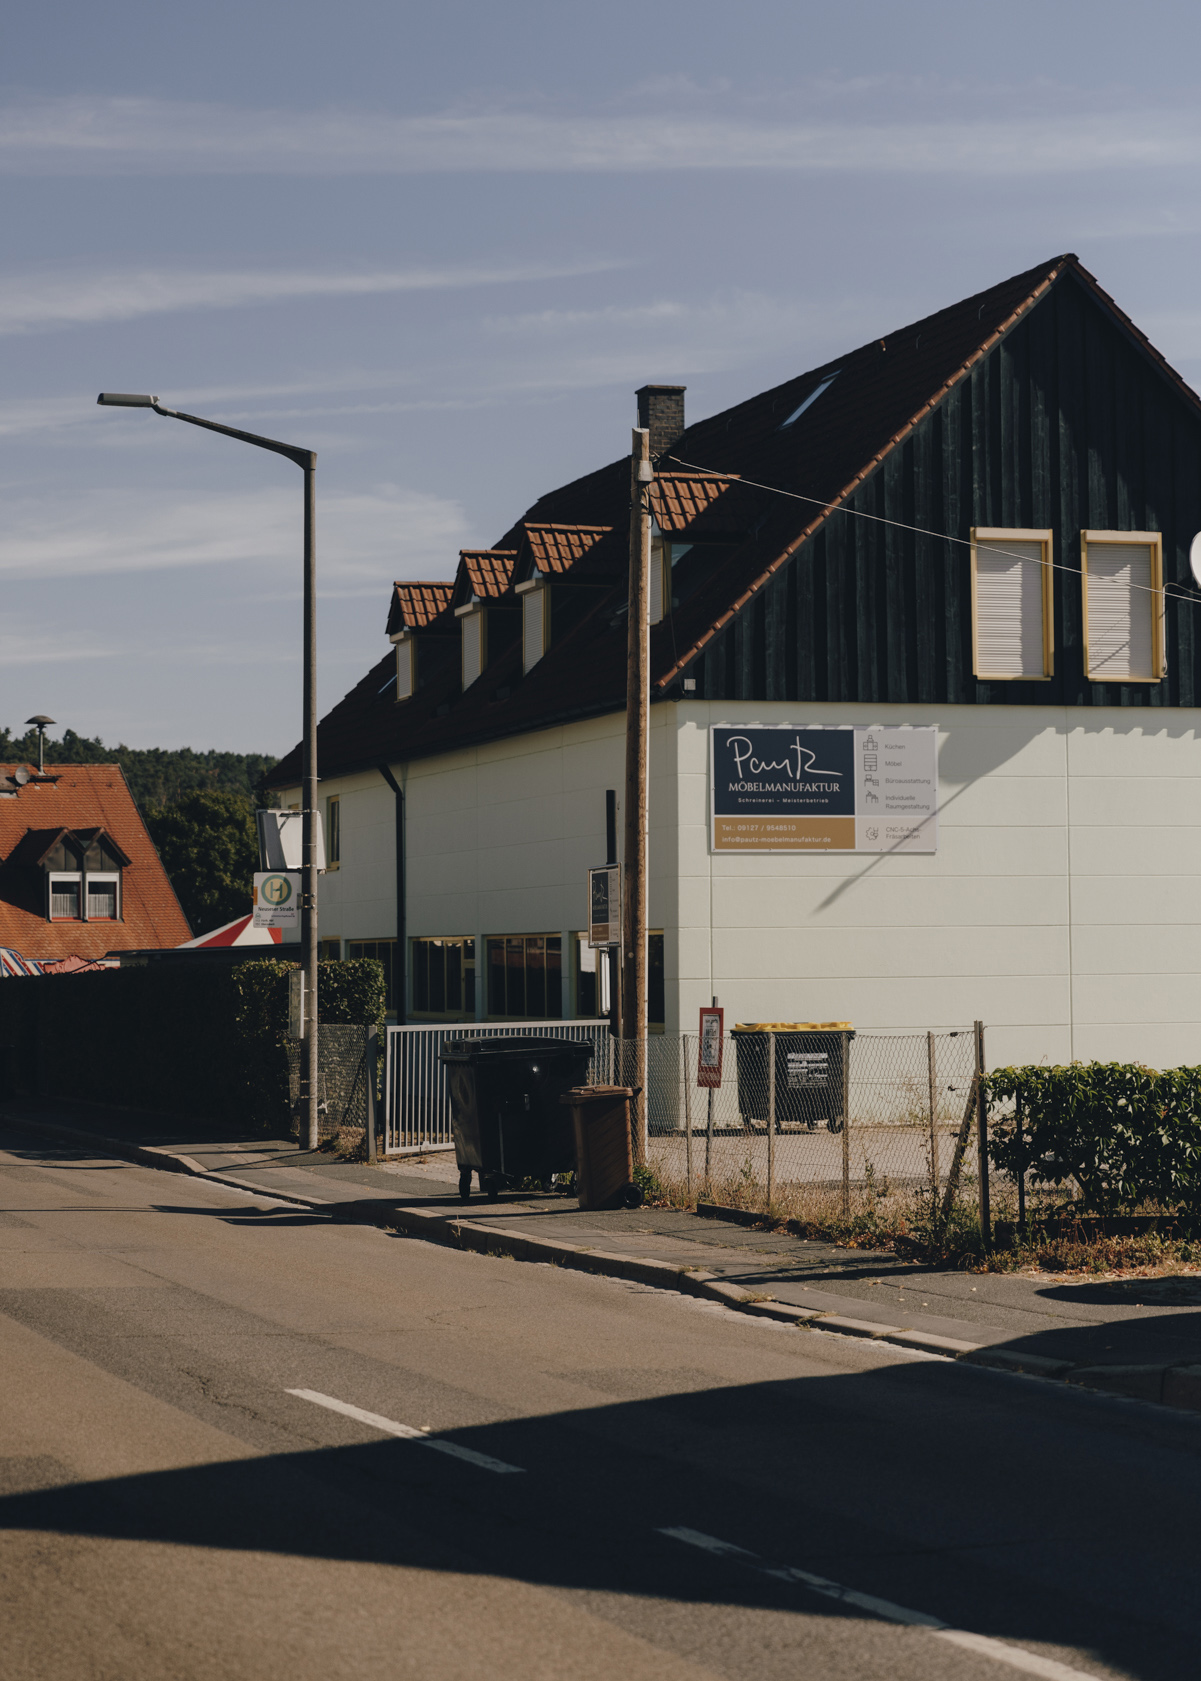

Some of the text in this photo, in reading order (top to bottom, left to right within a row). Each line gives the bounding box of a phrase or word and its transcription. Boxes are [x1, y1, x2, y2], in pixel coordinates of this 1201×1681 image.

[885, 777, 931, 785] Büroausstattung
[728, 781, 840, 792] MÖBELMANUFAKTUR
[885, 803, 930, 811] Raumgestaltung
[721, 836, 832, 844] info@pautz-moebelmanufaktur.de
[270, 882, 282, 898] H
